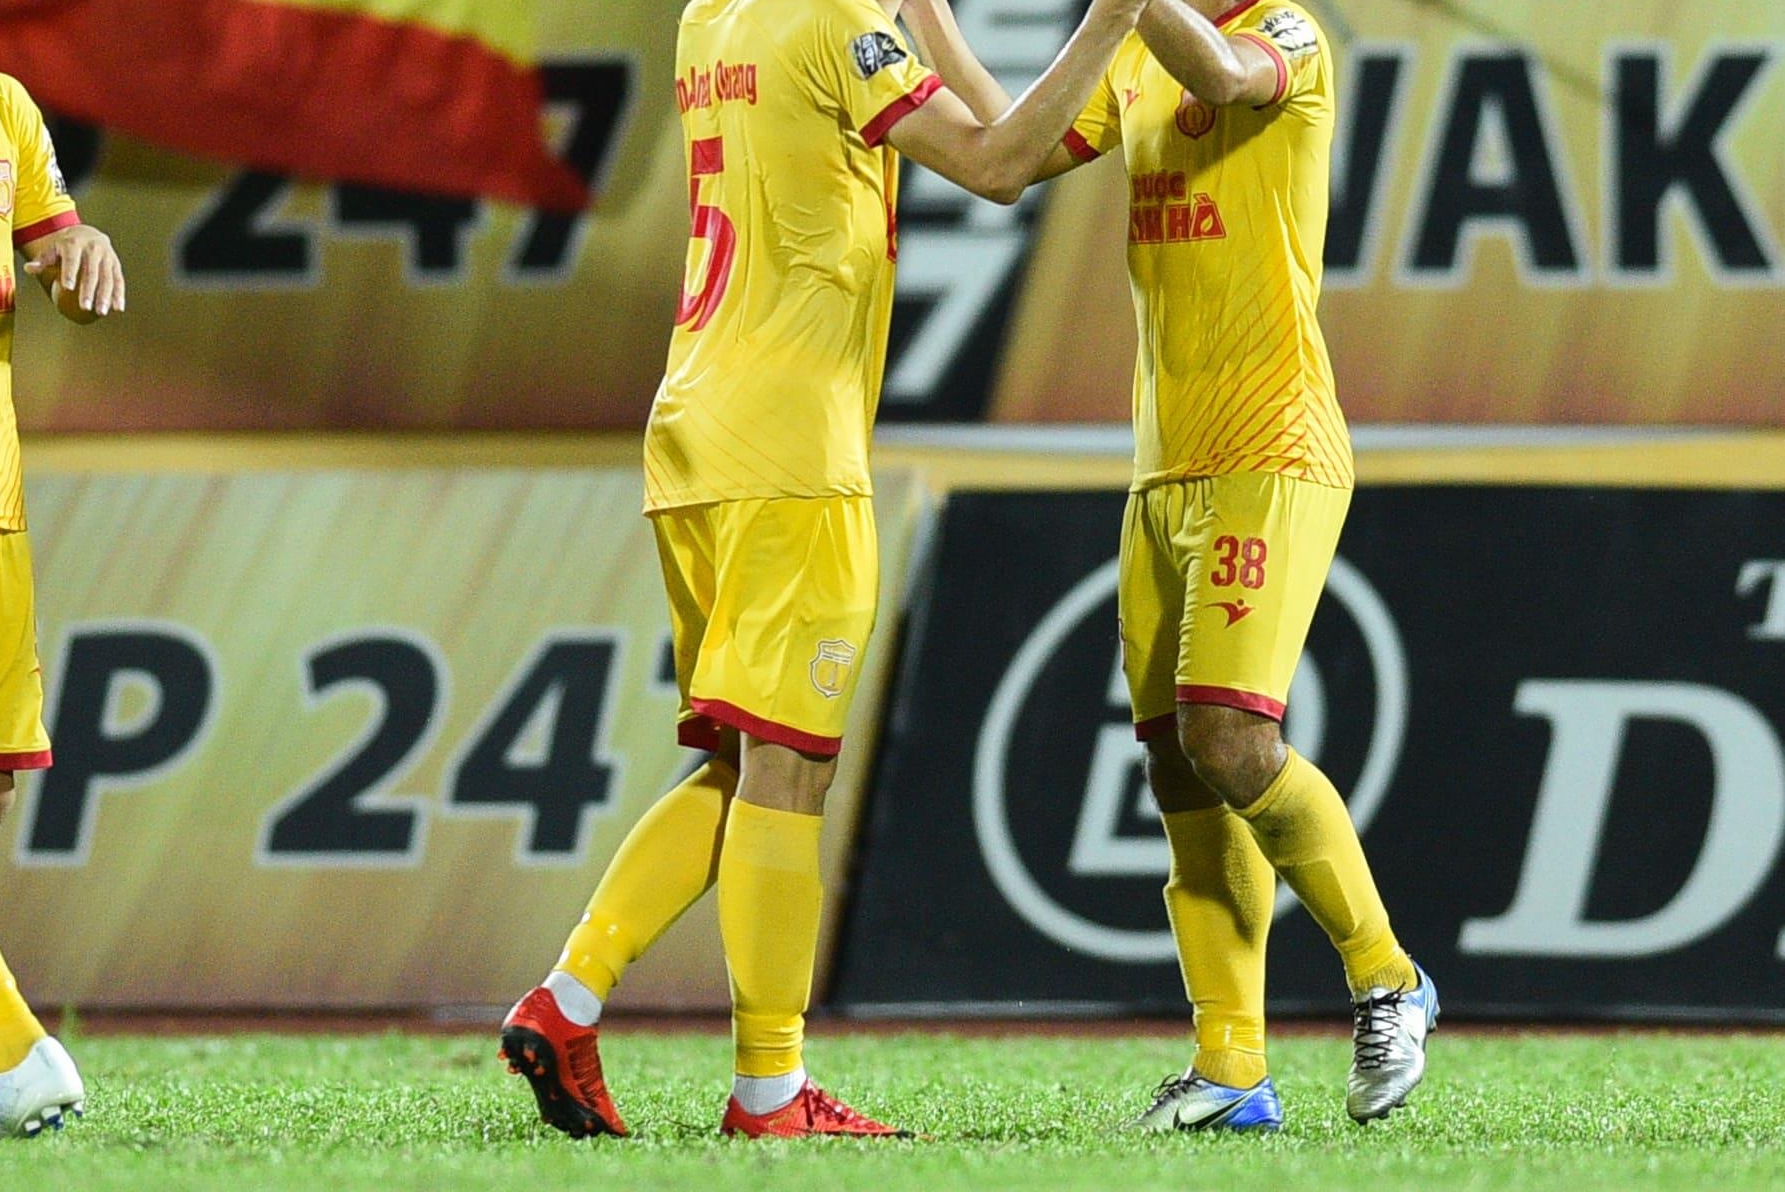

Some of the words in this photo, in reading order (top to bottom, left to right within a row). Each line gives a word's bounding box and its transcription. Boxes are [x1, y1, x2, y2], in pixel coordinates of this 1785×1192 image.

[675, 136, 737, 332] 5
[1210, 535, 1268, 590] 38
[1456, 676, 1785, 960] D
